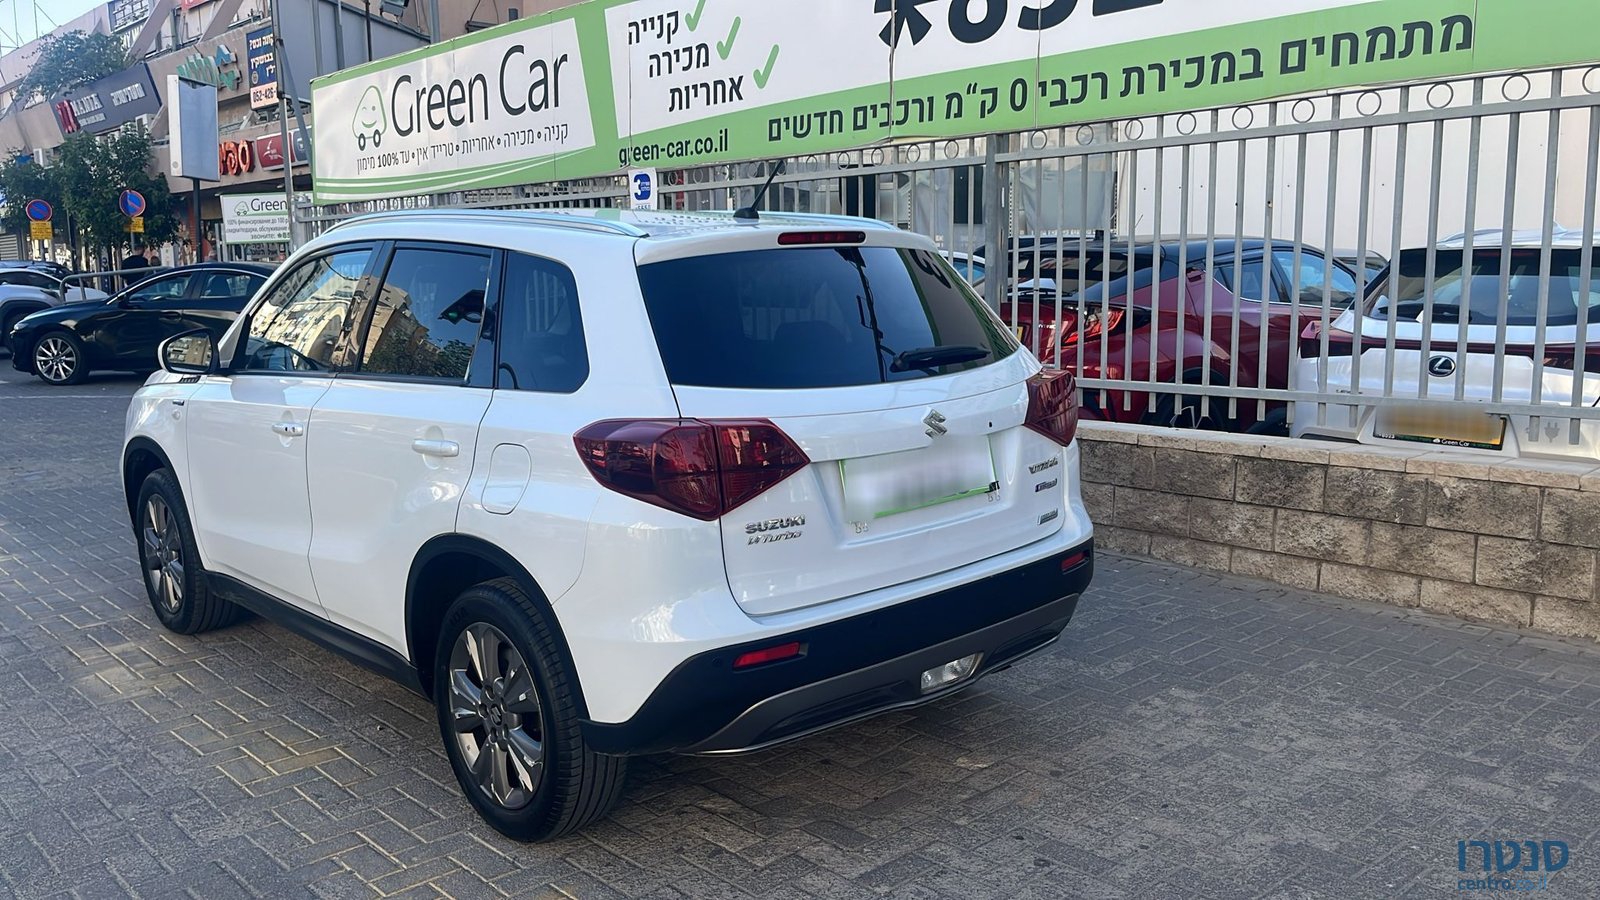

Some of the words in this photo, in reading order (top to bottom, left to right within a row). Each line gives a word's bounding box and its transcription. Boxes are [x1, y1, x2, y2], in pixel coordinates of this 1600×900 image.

[628, 10, 678, 44] קנייה
[1280, 14, 1473, 75] מתמחים
[650, 43, 710, 78] מכירה
[1120, 48, 1264, 97] במכירת
[391, 73, 488, 137] Green
[499, 44, 568, 116] Car
[668, 76, 744, 112] אחריות
[1009, 78, 1028, 112] 0
[1038, 72, 1108, 107] רכבי
[768, 110, 843, 142] חדשים
[852, 96, 934, 131] ורכבים
[462, 136, 495, 155] אחריות
[504, 128, 534, 148] מכירה
[544, 123, 568, 144] קניה
[377, 153, 400, 168] 100%
[400, 151, 410, 164] עד
[416, 146, 428, 166] אין
[430, 142, 454, 157] טרייד
[619, 128, 728, 167] green-car.co.il
[356, 156, 376, 175] מימון
[250, 198, 288, 212] Green
[1441, 438, 1458, 446] Green
[744, 514, 806, 534] SUZUKI
